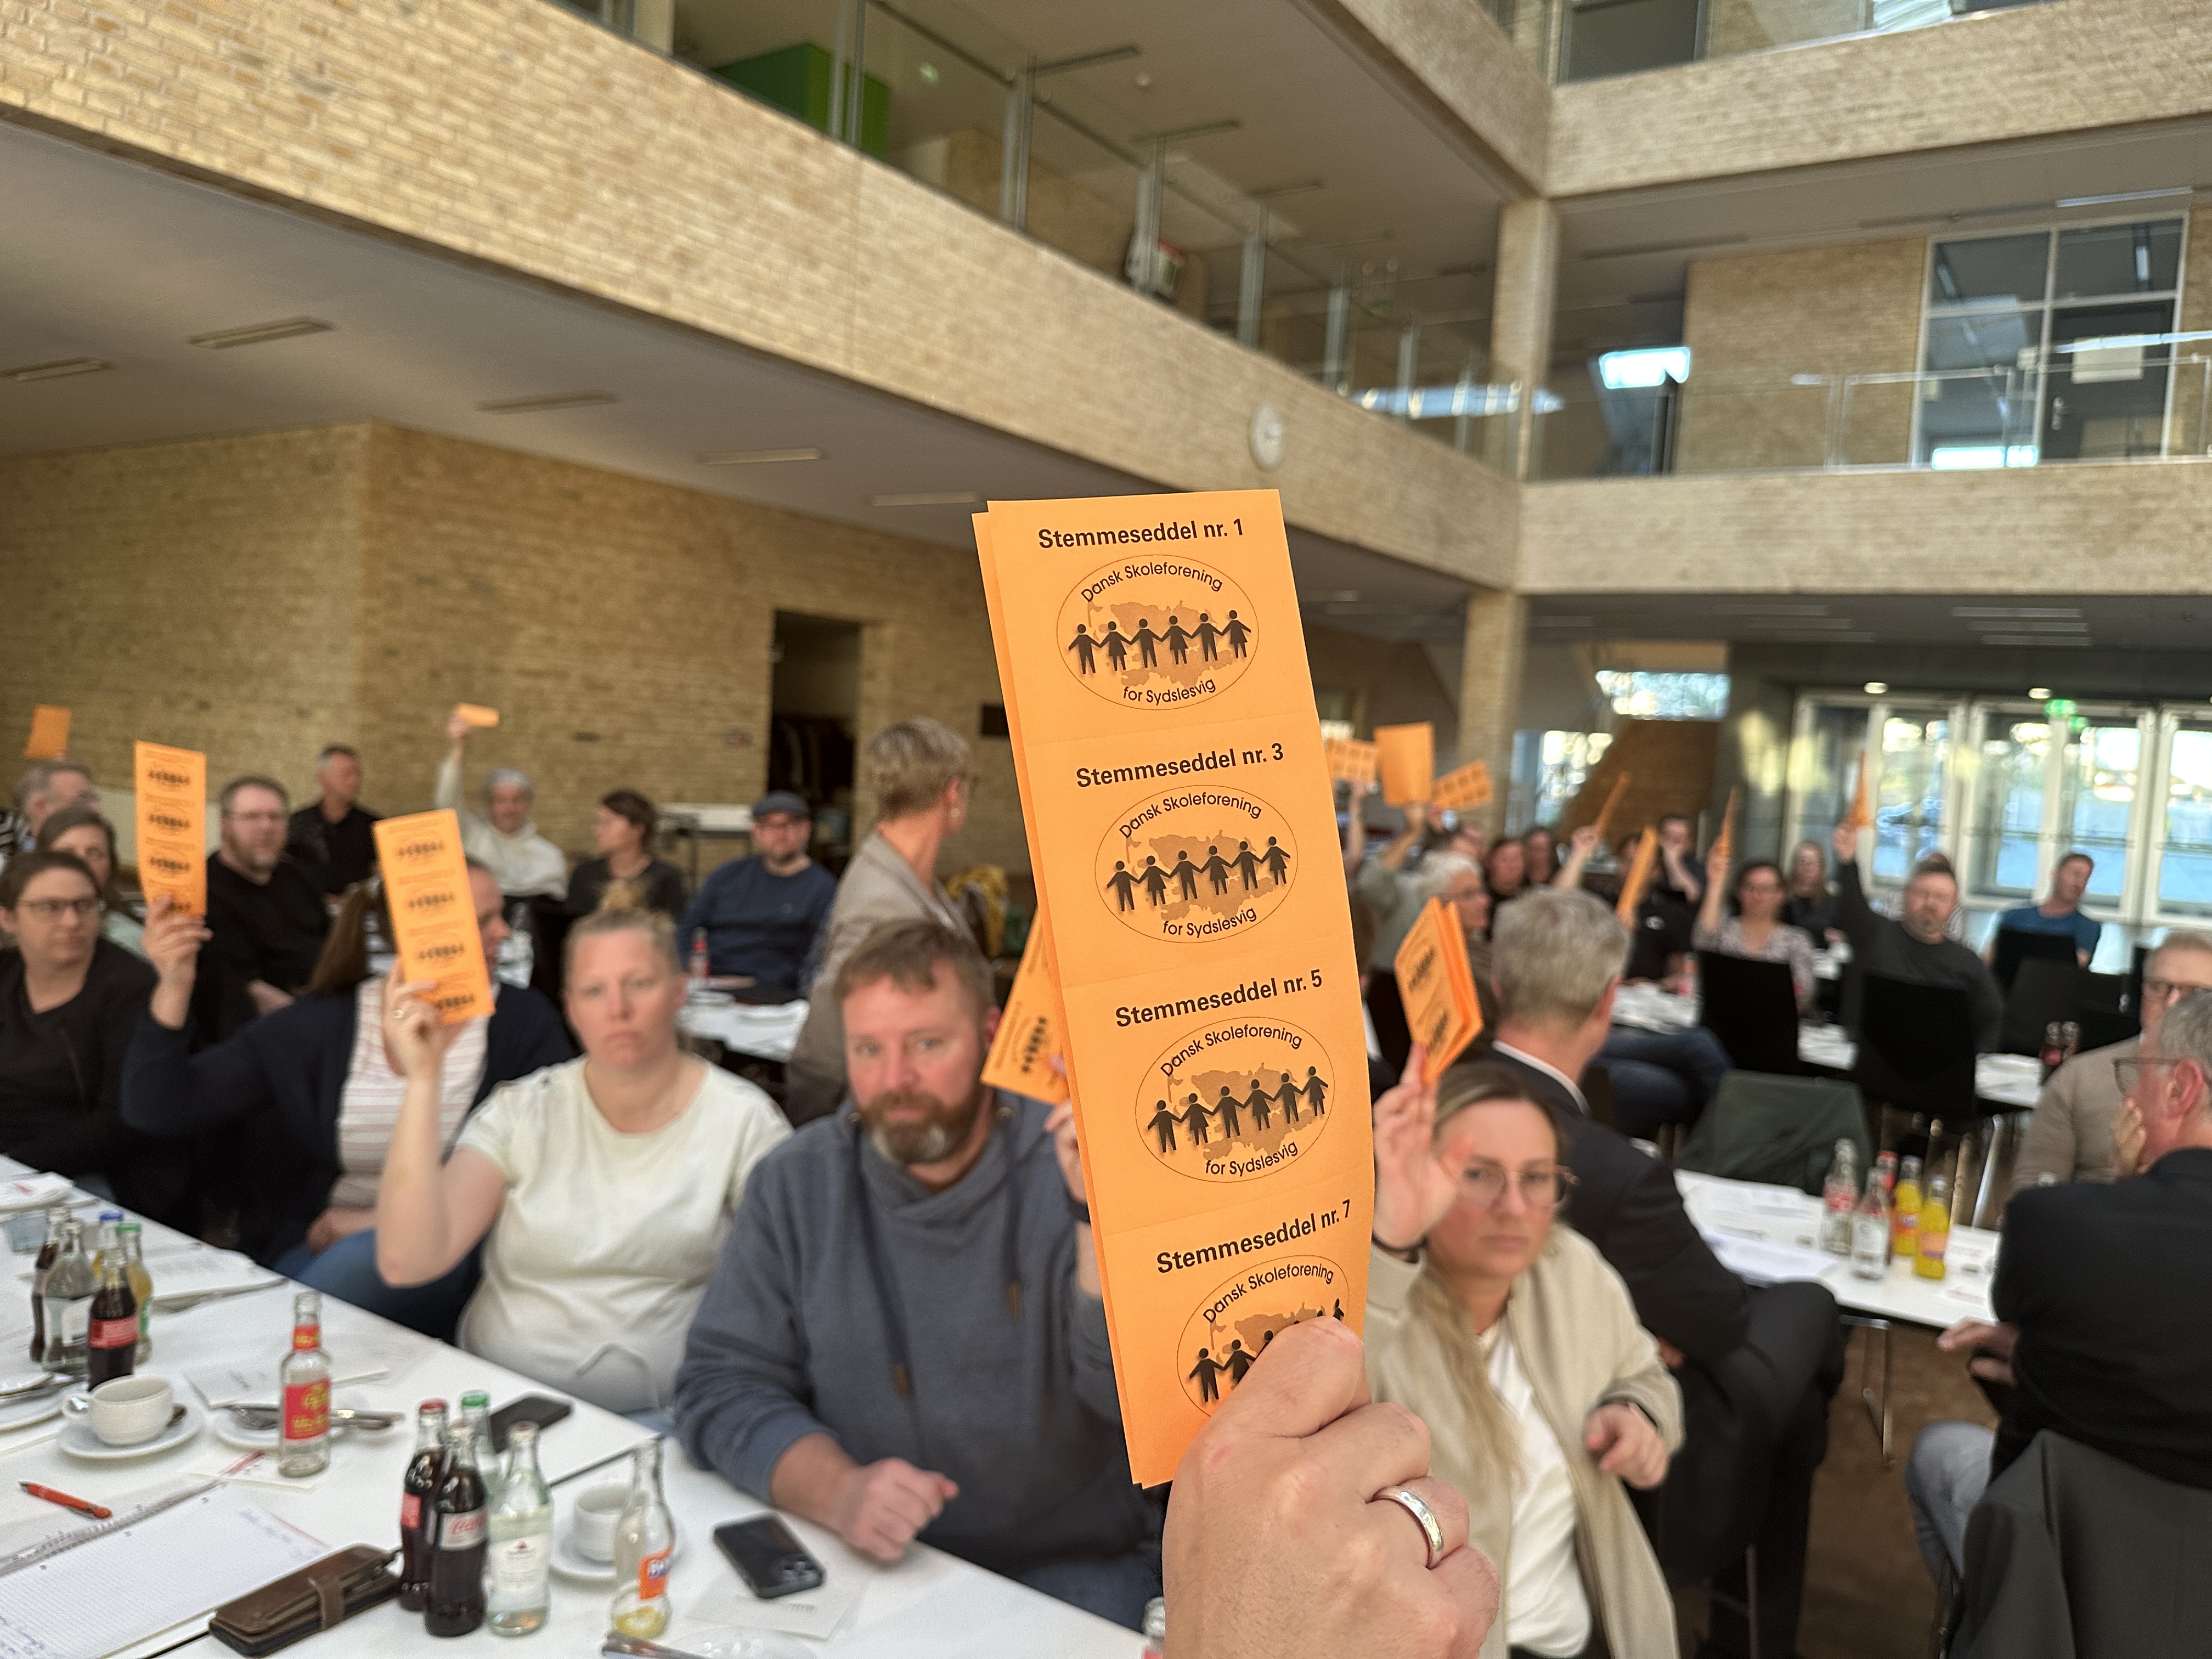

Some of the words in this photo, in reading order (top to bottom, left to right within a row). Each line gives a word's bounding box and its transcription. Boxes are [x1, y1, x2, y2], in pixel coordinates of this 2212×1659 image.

[1039, 520, 1198, 549] Stemmeseddel
[1203, 523, 1228, 538] nr.
[1233, 518, 1243, 535] 1
[1081, 570, 1124, 603] Dansk
[1124, 562, 1223, 592] Skoleforening
[1123, 686, 1143, 702] for
[1146, 679, 1216, 706] Sydslesvig
[1076, 748, 1237, 787] Stemmeseddel
[1242, 749, 1267, 766] nr.
[1271, 742, 1284, 761] 3
[1119, 804, 1163, 839] Dansk
[1163, 792, 1262, 819] Skoleforening
[1163, 920, 1183, 935] for
[1186, 907, 1257, 939] Sydslesvig
[1115, 977, 1278, 1027] Stemmeseddel
[1283, 977, 1307, 995] nr.
[1311, 969, 1322, 988] 5
[1160, 1040, 1205, 1077] Dansk
[1205, 1024, 1302, 1049] Skoleforening
[1205, 1160, 1226, 1175] for
[1229, 1141, 1298, 1177] Sydslesvig
[1156, 1212, 1316, 1273] Stemmeseddel
[1321, 1209, 1340, 1229] nr.
[1342, 1198, 1350, 1218] 7
[1203, 1283, 1248, 1324] Dansk
[1248, 1263, 1334, 1290] Skoleforening
